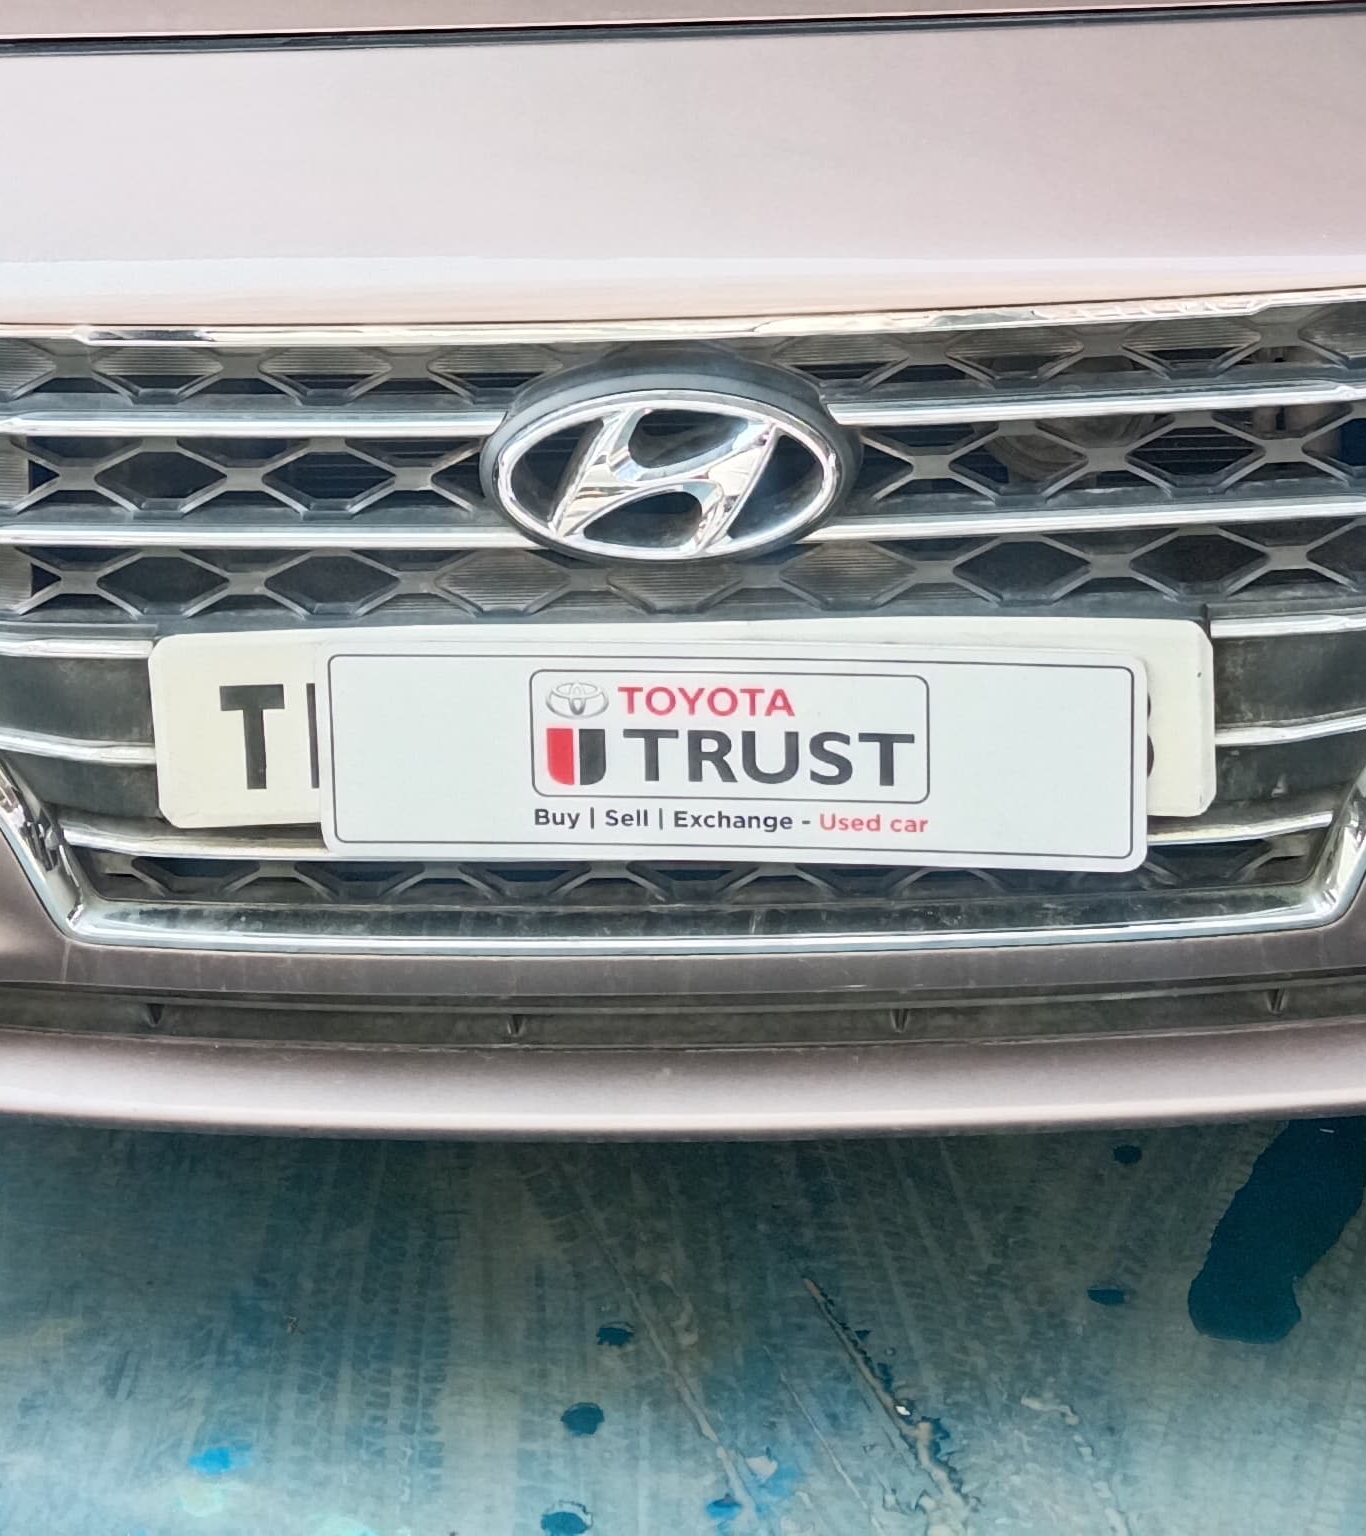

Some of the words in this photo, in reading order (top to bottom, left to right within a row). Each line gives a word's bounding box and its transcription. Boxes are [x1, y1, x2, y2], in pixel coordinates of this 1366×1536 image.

[618, 686, 795, 717] TOYOTA
[623, 728, 915, 787] TRUST
[535, 808, 581, 830] Buy
[605, 808, 649, 827] Sell
[673, 810, 794, 833] Exchange
[819, 812, 882, 832] Used
[890, 817, 929, 833] car
